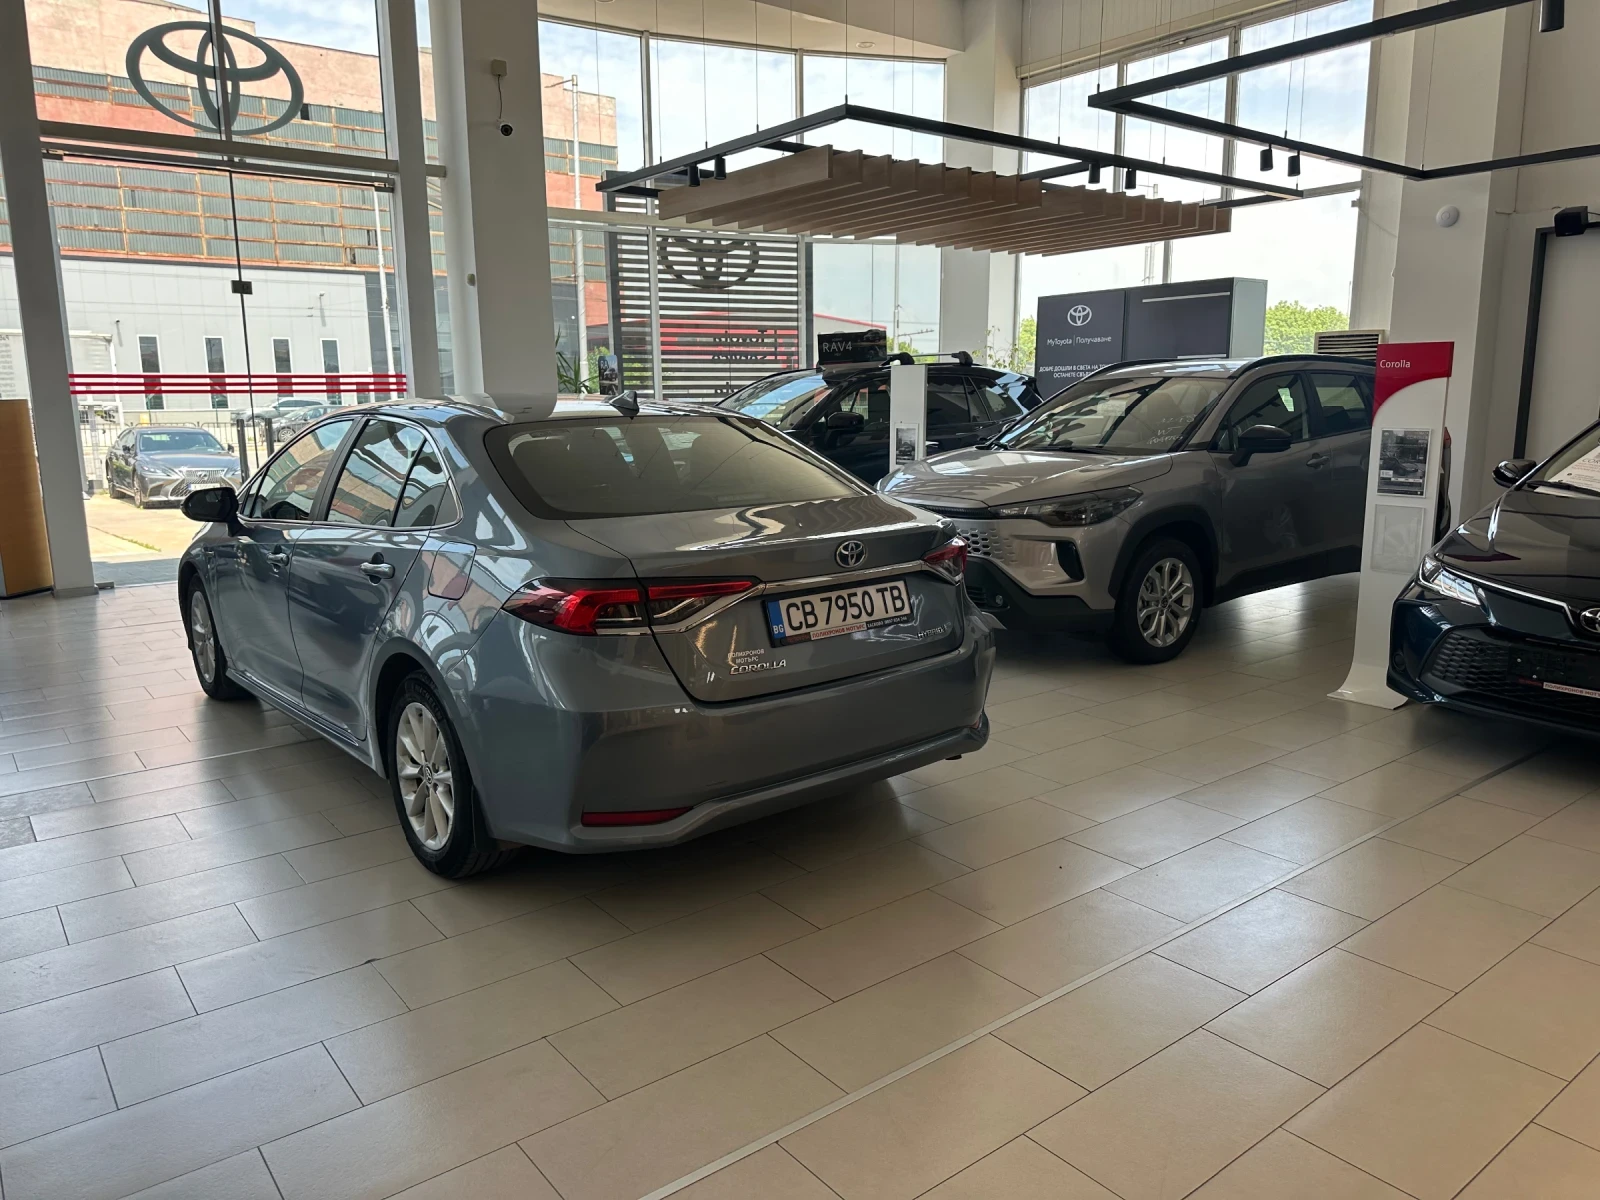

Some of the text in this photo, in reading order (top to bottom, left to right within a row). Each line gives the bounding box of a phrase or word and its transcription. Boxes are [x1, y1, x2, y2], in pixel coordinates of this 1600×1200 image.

[1047, 338, 1072, 347] MyToyota
[1076, 336, 1112, 345] Получаване
[822, 341, 852, 353] RAV4
[1380, 359, 1411, 368] Corolla
[820, 590, 875, 625] 7950
[773, 624, 784, 634] BG
[812, 627, 845, 639] ПОЛИХРОНОВ
[846, 623, 866, 632] МОТЪРС
[728, 648, 765, 658] ПОЛИХРОНОВ
[736, 656, 759, 664] МОТЪРС
[730, 659, 787, 675] COROLLA
[1545, 683, 1583, 694] ПОЛИХРОНОВ
